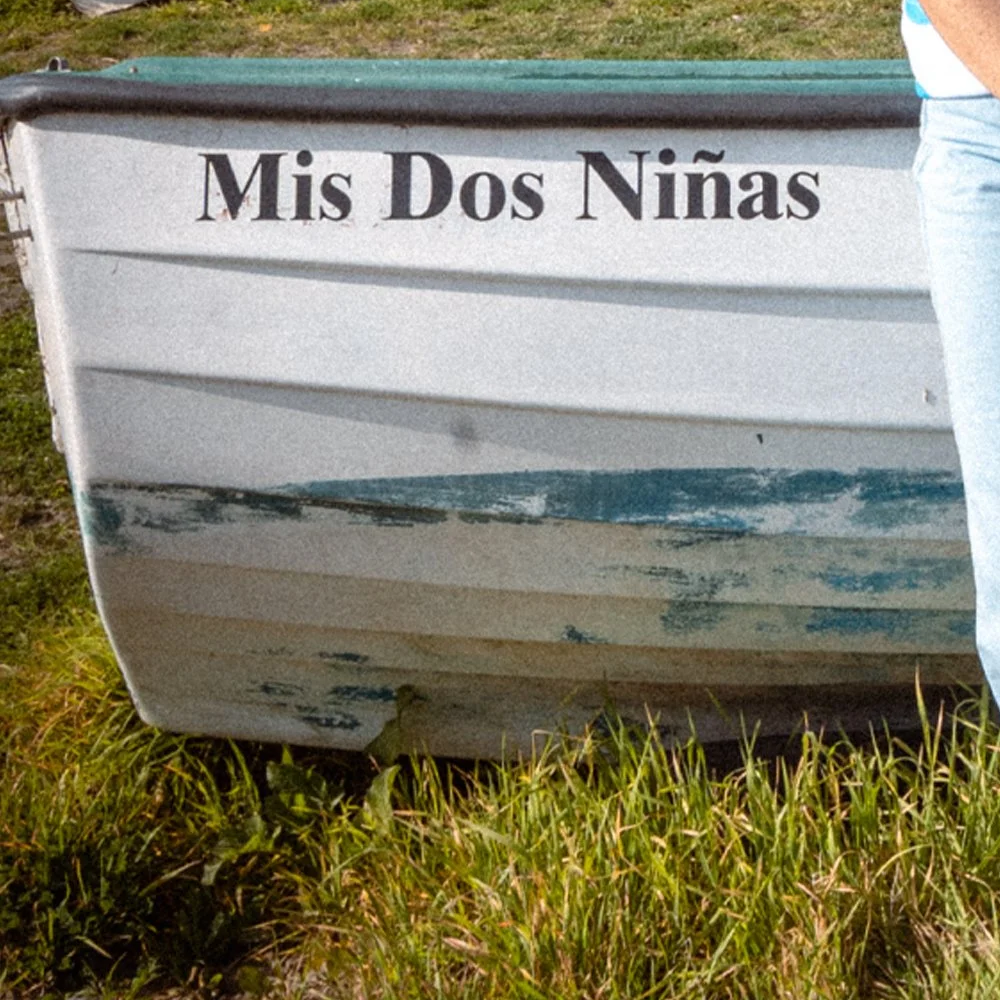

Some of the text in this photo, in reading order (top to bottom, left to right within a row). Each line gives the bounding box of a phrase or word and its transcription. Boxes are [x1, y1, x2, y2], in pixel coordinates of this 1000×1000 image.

[196, 148, 820, 222] Mis Dos Niñas
